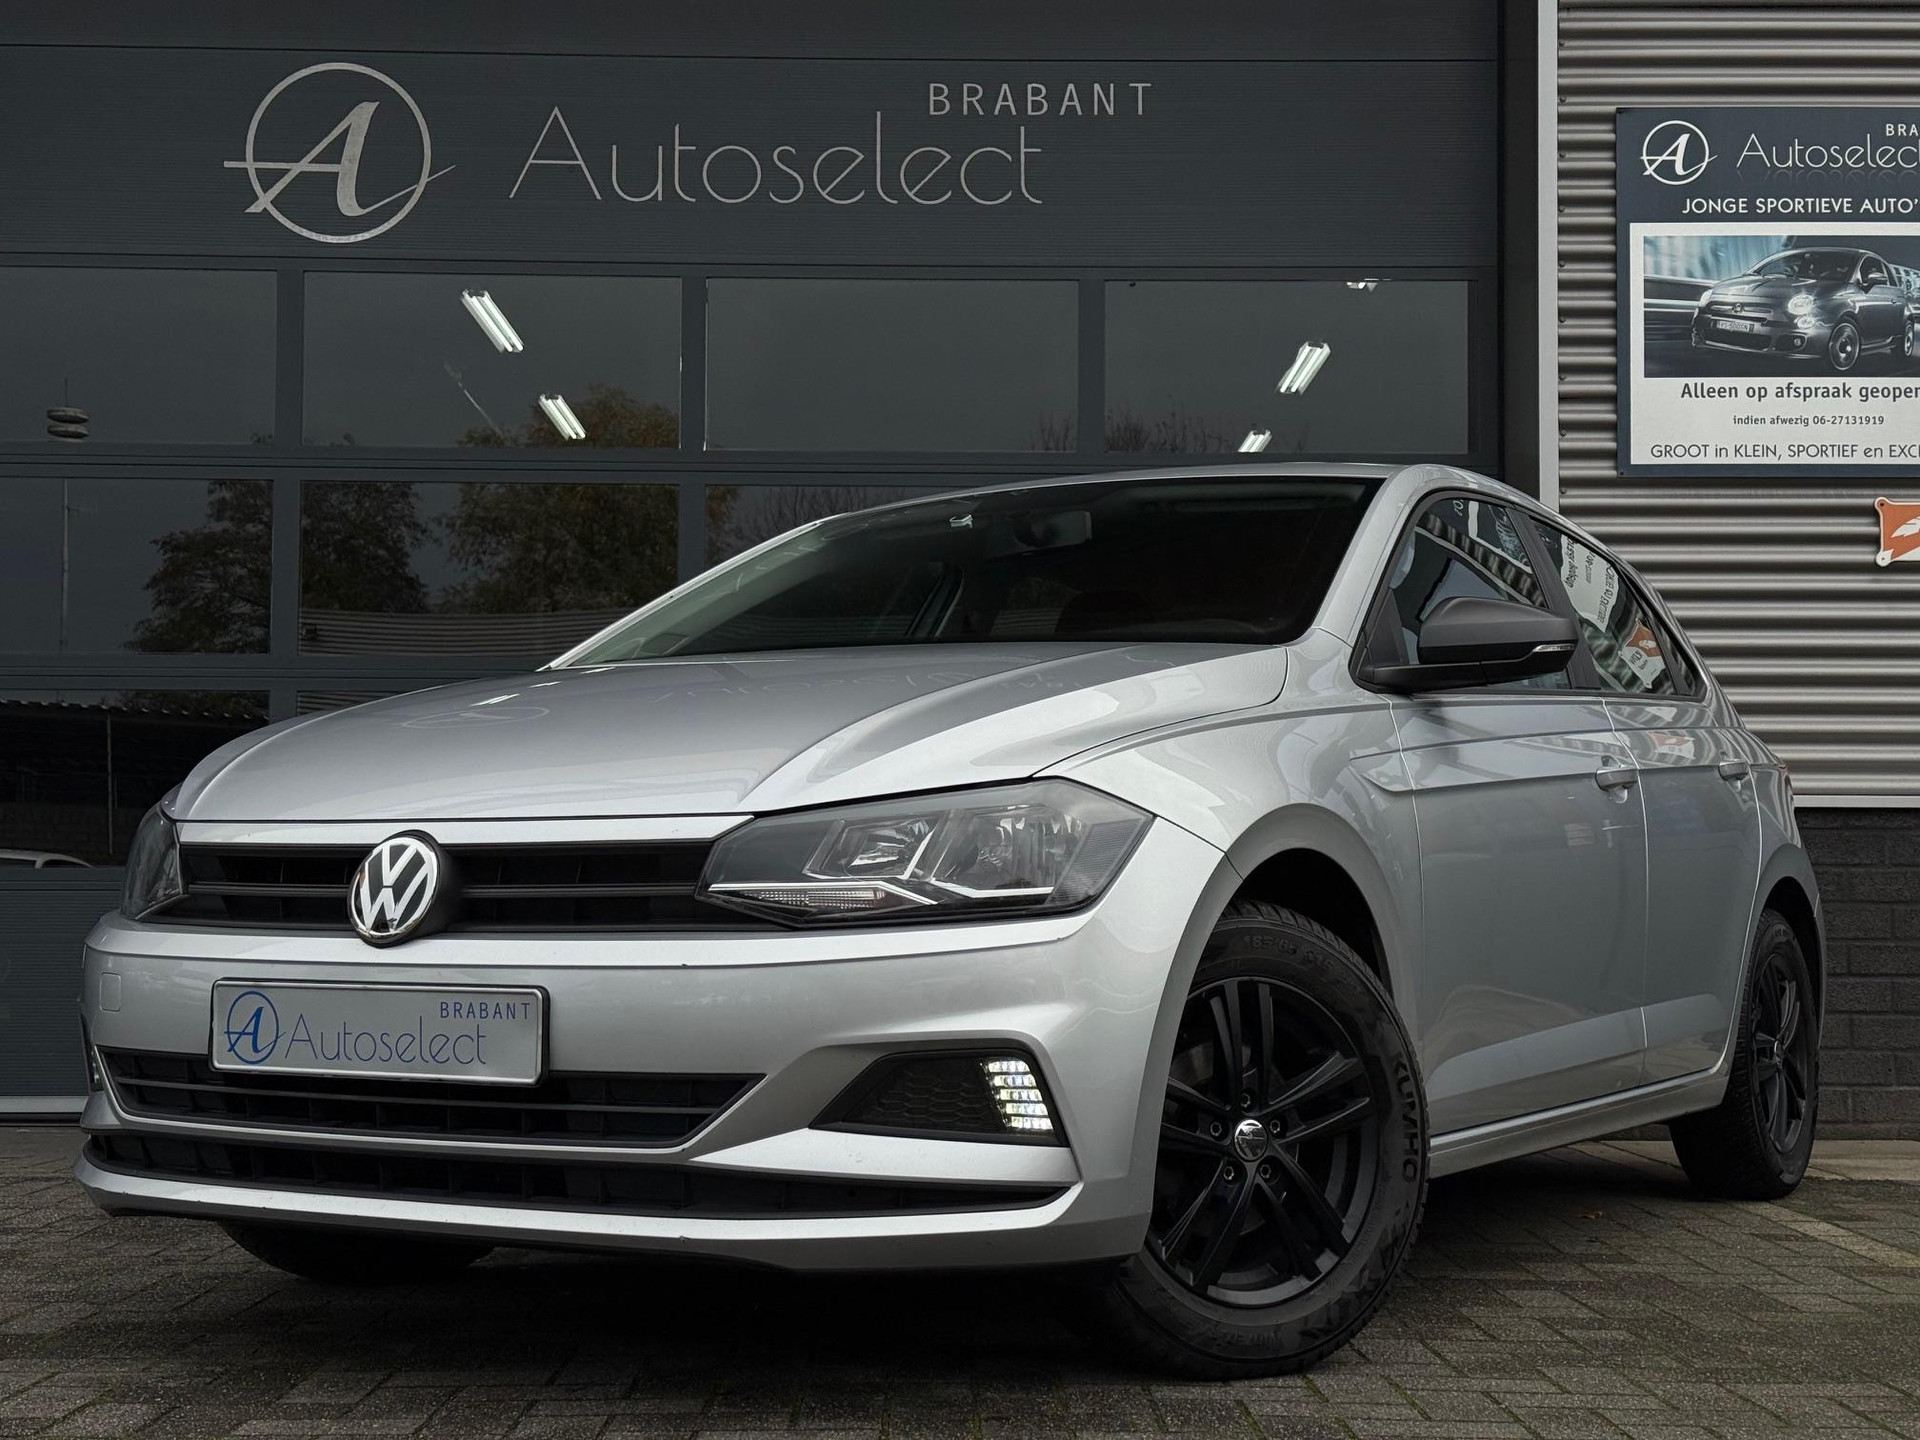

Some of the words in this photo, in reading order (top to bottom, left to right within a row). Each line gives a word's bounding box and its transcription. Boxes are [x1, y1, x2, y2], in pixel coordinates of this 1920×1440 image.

[929, 82, 1152, 117] BRABANT
[508, 106, 1044, 206] Autoselect
[1736, 132, 1920, 169] Autoselec
[1682, 197, 1749, 214] JONGE
[1755, 197, 1853, 214] SPORTIEVE
[1680, 382, 1739, 400] Alleen
[1745, 387, 1768, 403] op
[1774, 382, 1853, 403] afspraak
[1732, 414, 1767, 426] indien
[1769, 414, 1810, 428] afwezig
[1812, 414, 1885, 426] 06-27131919
[1650, 444, 1710, 459] GROOT
[1714, 444, 1729, 459] in
[1734, 444, 1782, 461] KLEIN,
[1787, 444, 1859, 459] SPORTIEF
[1863, 448, 1884, 459] en
[1888, 444, 1920, 459] EXC
[440, 1001, 531, 1020] BRABANT
[284, 1012, 488, 1066] Autoselect
[1392, 1054, 1420, 1183] KUMHO
